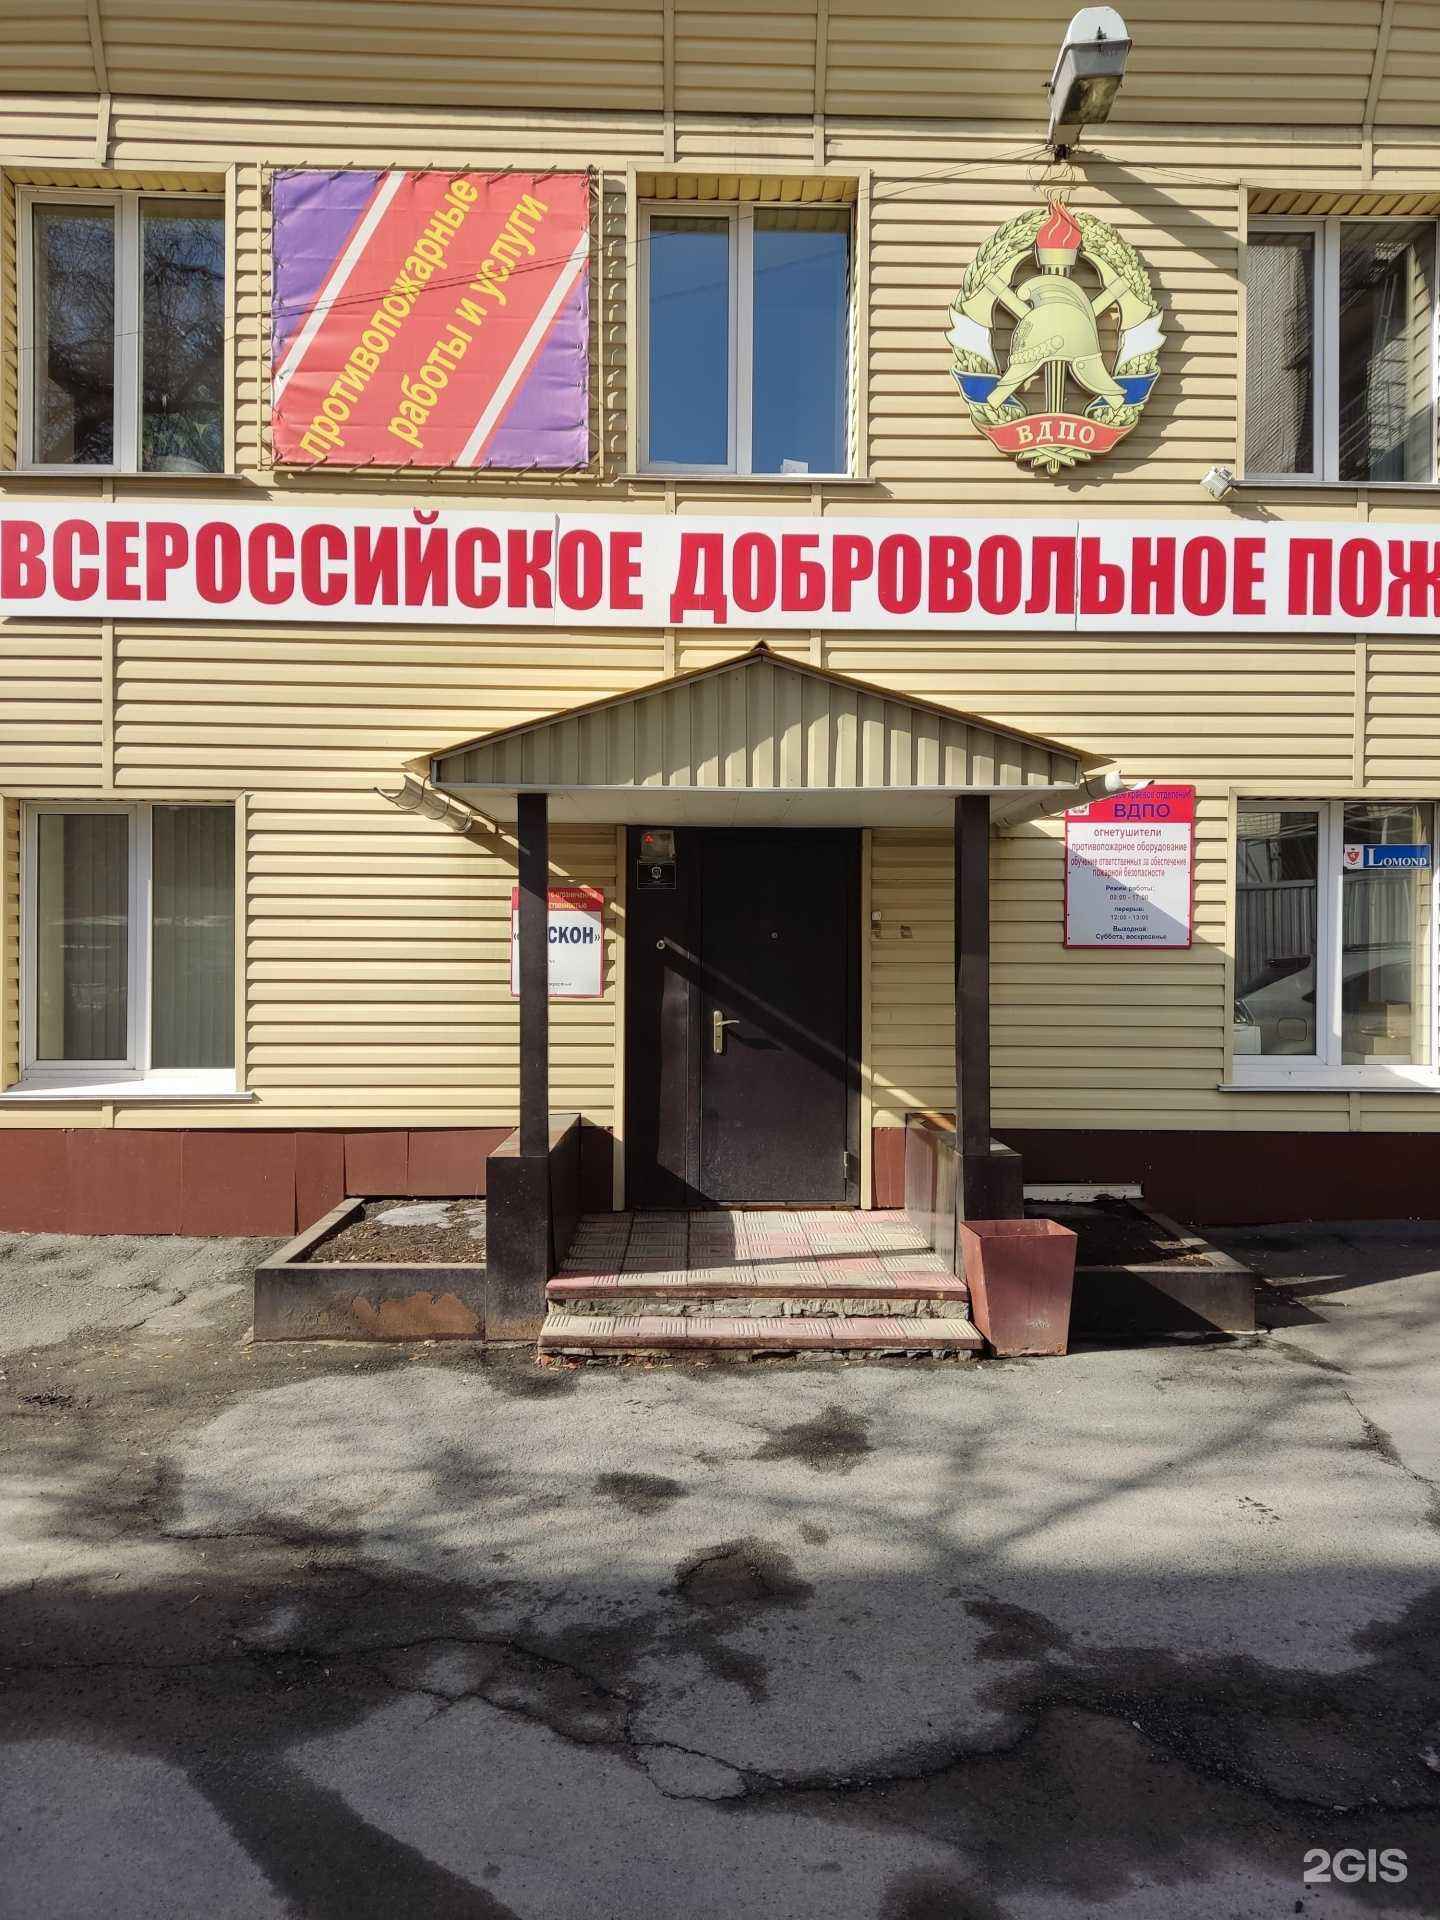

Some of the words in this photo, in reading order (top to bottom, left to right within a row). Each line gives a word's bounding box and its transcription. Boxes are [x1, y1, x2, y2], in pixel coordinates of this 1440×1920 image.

[469, 193, 549, 306] услуги
[300, 179, 479, 460] противопожарные
[455, 296, 488, 327] и
[387, 323, 473, 449] работы
[1016, 420, 1096, 446] ВДПО
[1, 509, 642, 610] ВСЕРОССИЙСКОЕ
[670, 531, 1266, 625] ДОБРОВОЛЬНОЕ
[1288, 538, 1440, 618] ПОЖ
[1114, 803, 1170, 820] ВДПО
[1094, 829, 1162, 838] огнетушители
[1072, 843, 1135, 854] противопожарное
[1137, 841, 1187, 854] оборудование
[1071, 857, 1097, 869] обучение
[1093, 868, 1123, 879] пожарной
[1124, 867, 1165, 877] безопасности
